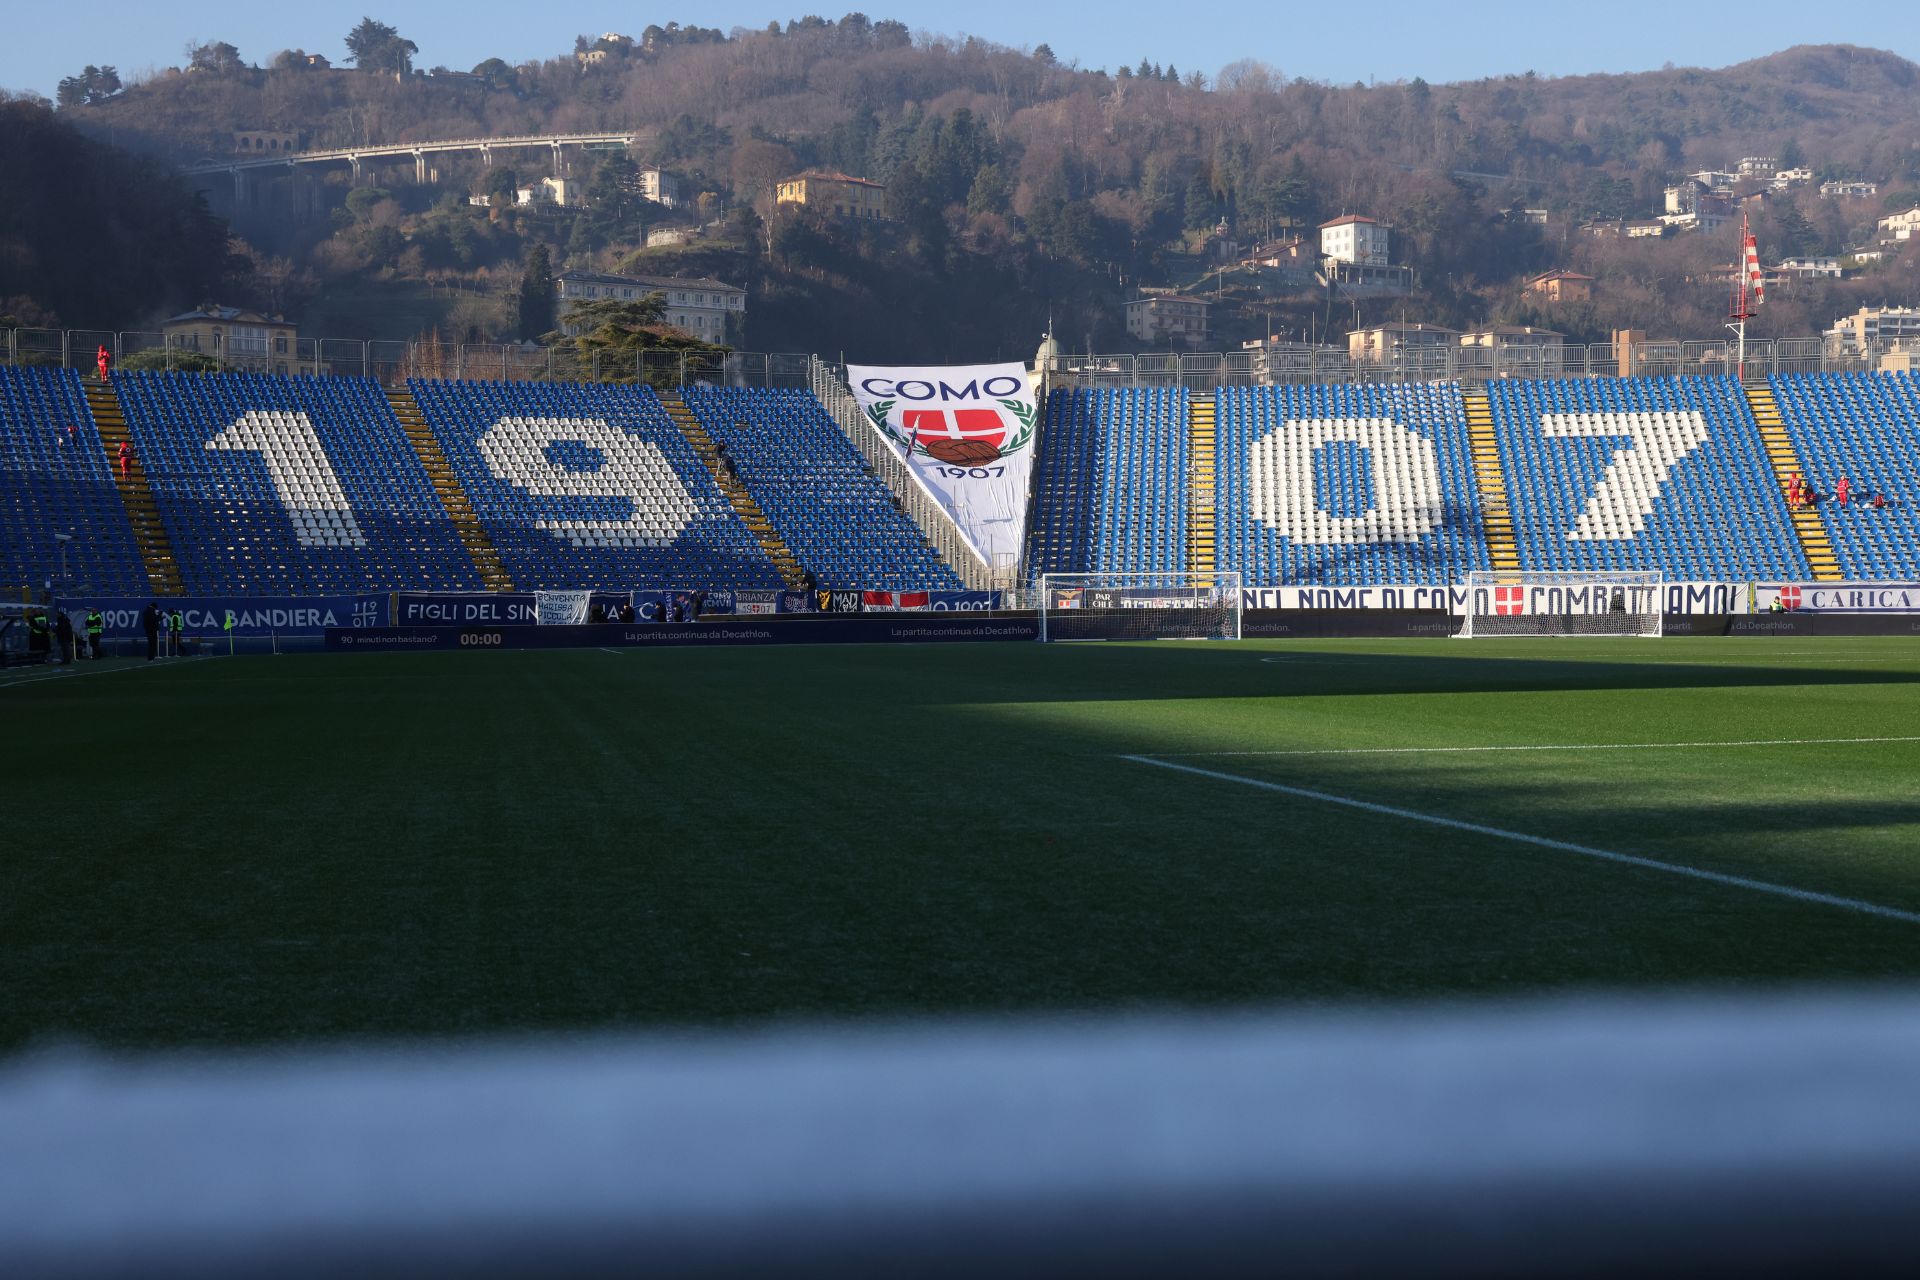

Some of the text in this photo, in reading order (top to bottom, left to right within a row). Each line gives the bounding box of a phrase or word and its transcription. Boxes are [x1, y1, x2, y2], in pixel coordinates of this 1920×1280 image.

[861, 376, 1022, 401] COMO
[936, 466, 1005, 479] 1907
[737, 592, 776, 602] BRIANZA
[1300, 588, 1373, 608] NOME
[1382, 588, 1404, 608] DI
[1811, 590, 1911, 608] CARICA
[224, 608, 339, 628] BANDIERA
[408, 604, 457, 620] FIGLI
[465, 604, 501, 620] DEL
[891, 625, 1034, 637] La partita continua da Decathlon.
[1242, 623, 1291, 632] Decathlon.
[1418, 623, 1447, 632] partita
[1748, 620, 1796, 630] Decathlon.
[341, 635, 353, 645] 90
[382, 636, 398, 644] non
[398, 634, 438, 644] bastano?
[460, 633, 502, 645] 00:00
[625, 628, 772, 642] La partita continua da Decathlon.
